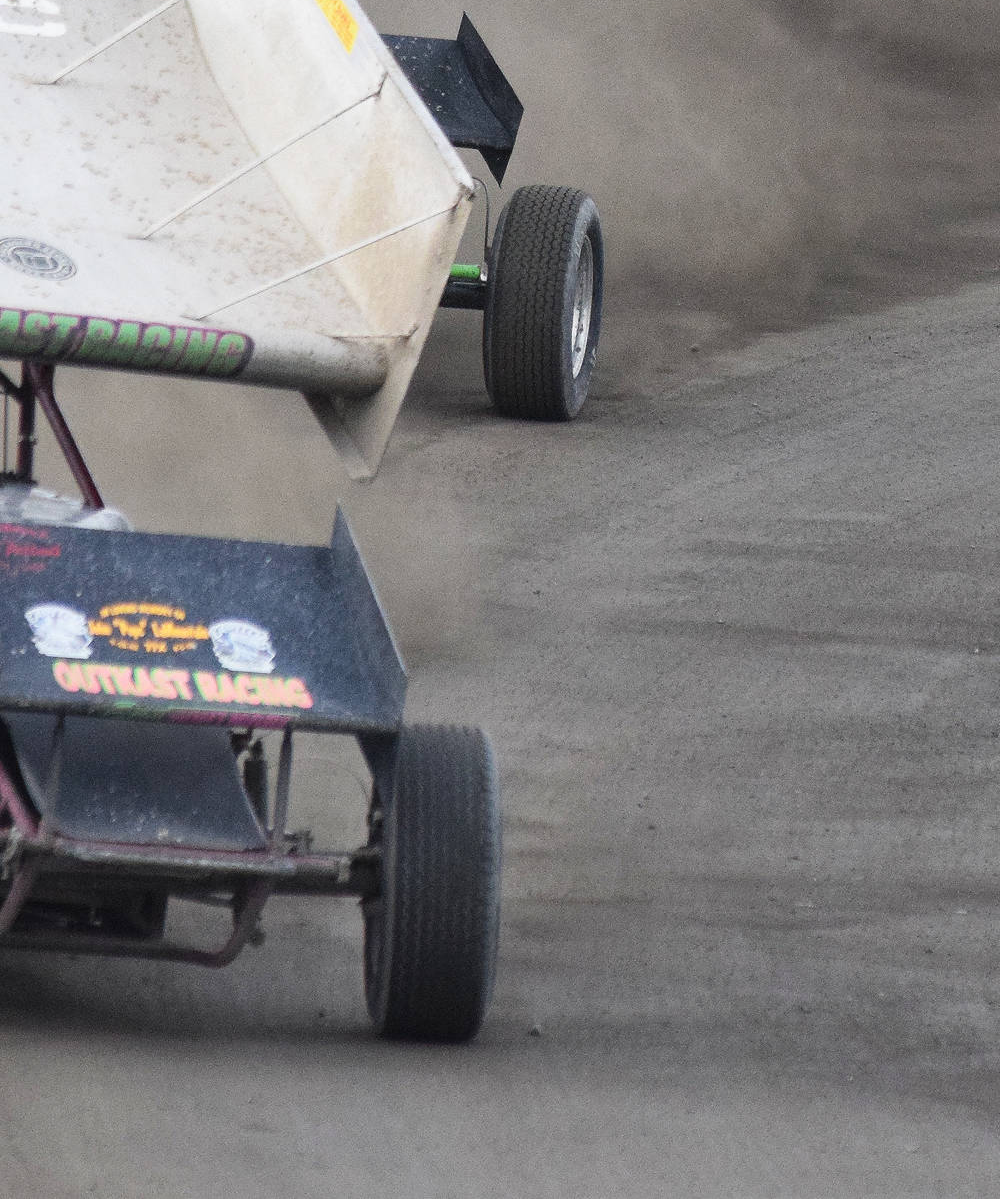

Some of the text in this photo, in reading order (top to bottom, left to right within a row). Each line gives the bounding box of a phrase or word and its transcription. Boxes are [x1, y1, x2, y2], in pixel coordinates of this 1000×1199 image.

[77, 316, 248, 378] RACING
[52, 659, 314, 709] OUTKAST RACING
